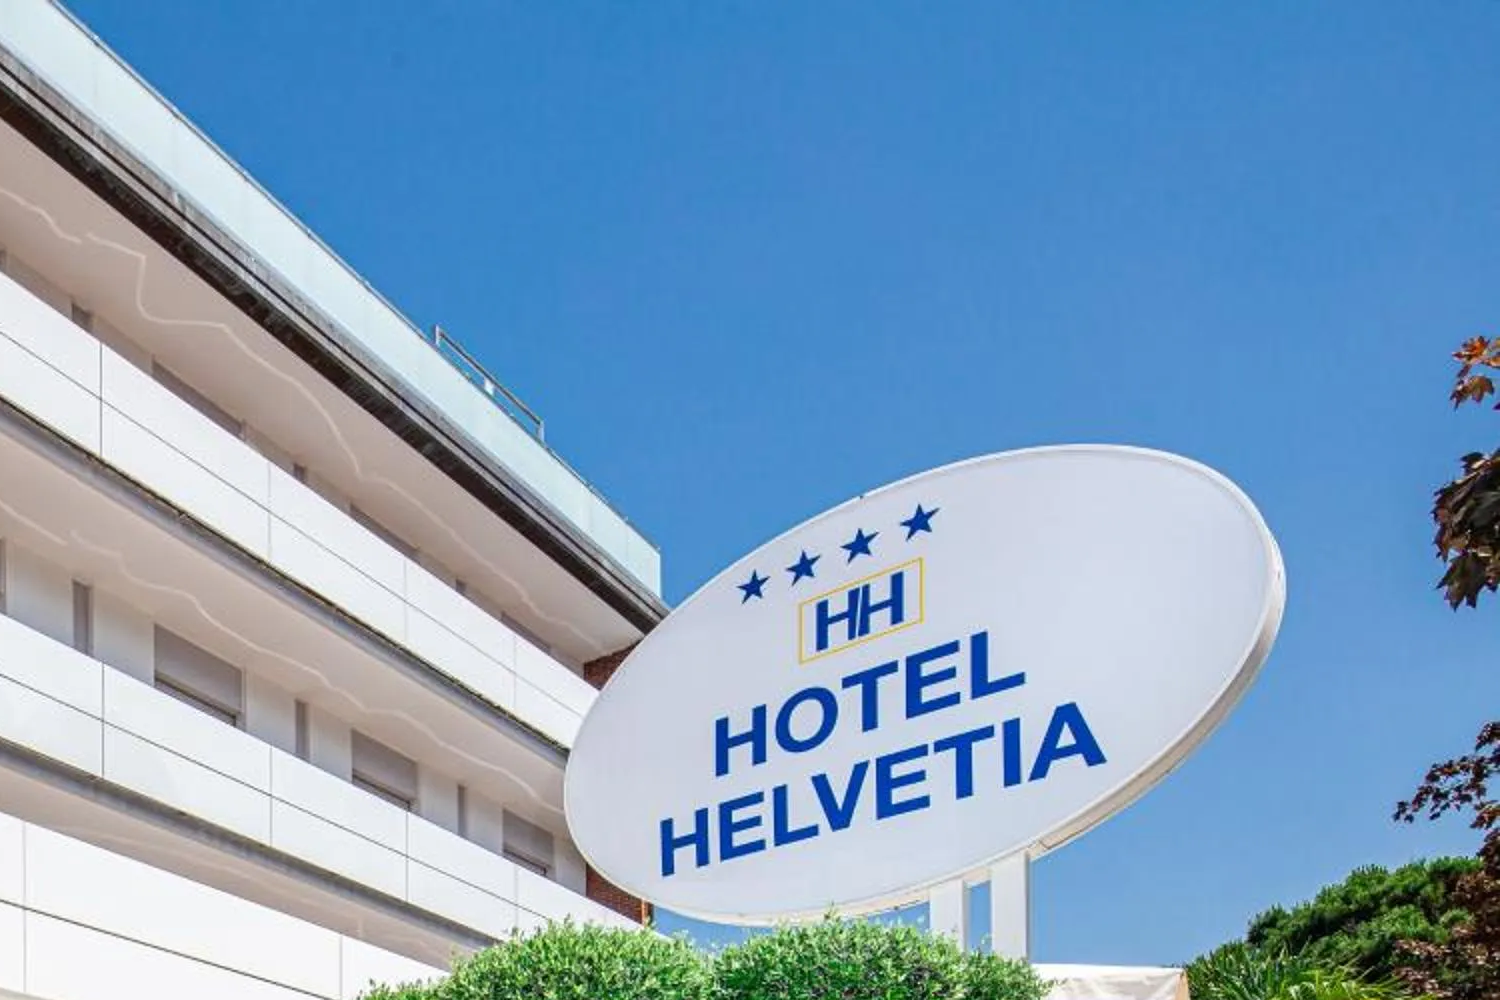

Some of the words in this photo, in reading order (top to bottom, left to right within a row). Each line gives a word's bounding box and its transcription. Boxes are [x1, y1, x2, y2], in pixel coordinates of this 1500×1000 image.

[816, 572, 903, 650] HH
[715, 631, 1026, 777] HOTEL
[661, 702, 1107, 876] HELVETIA
